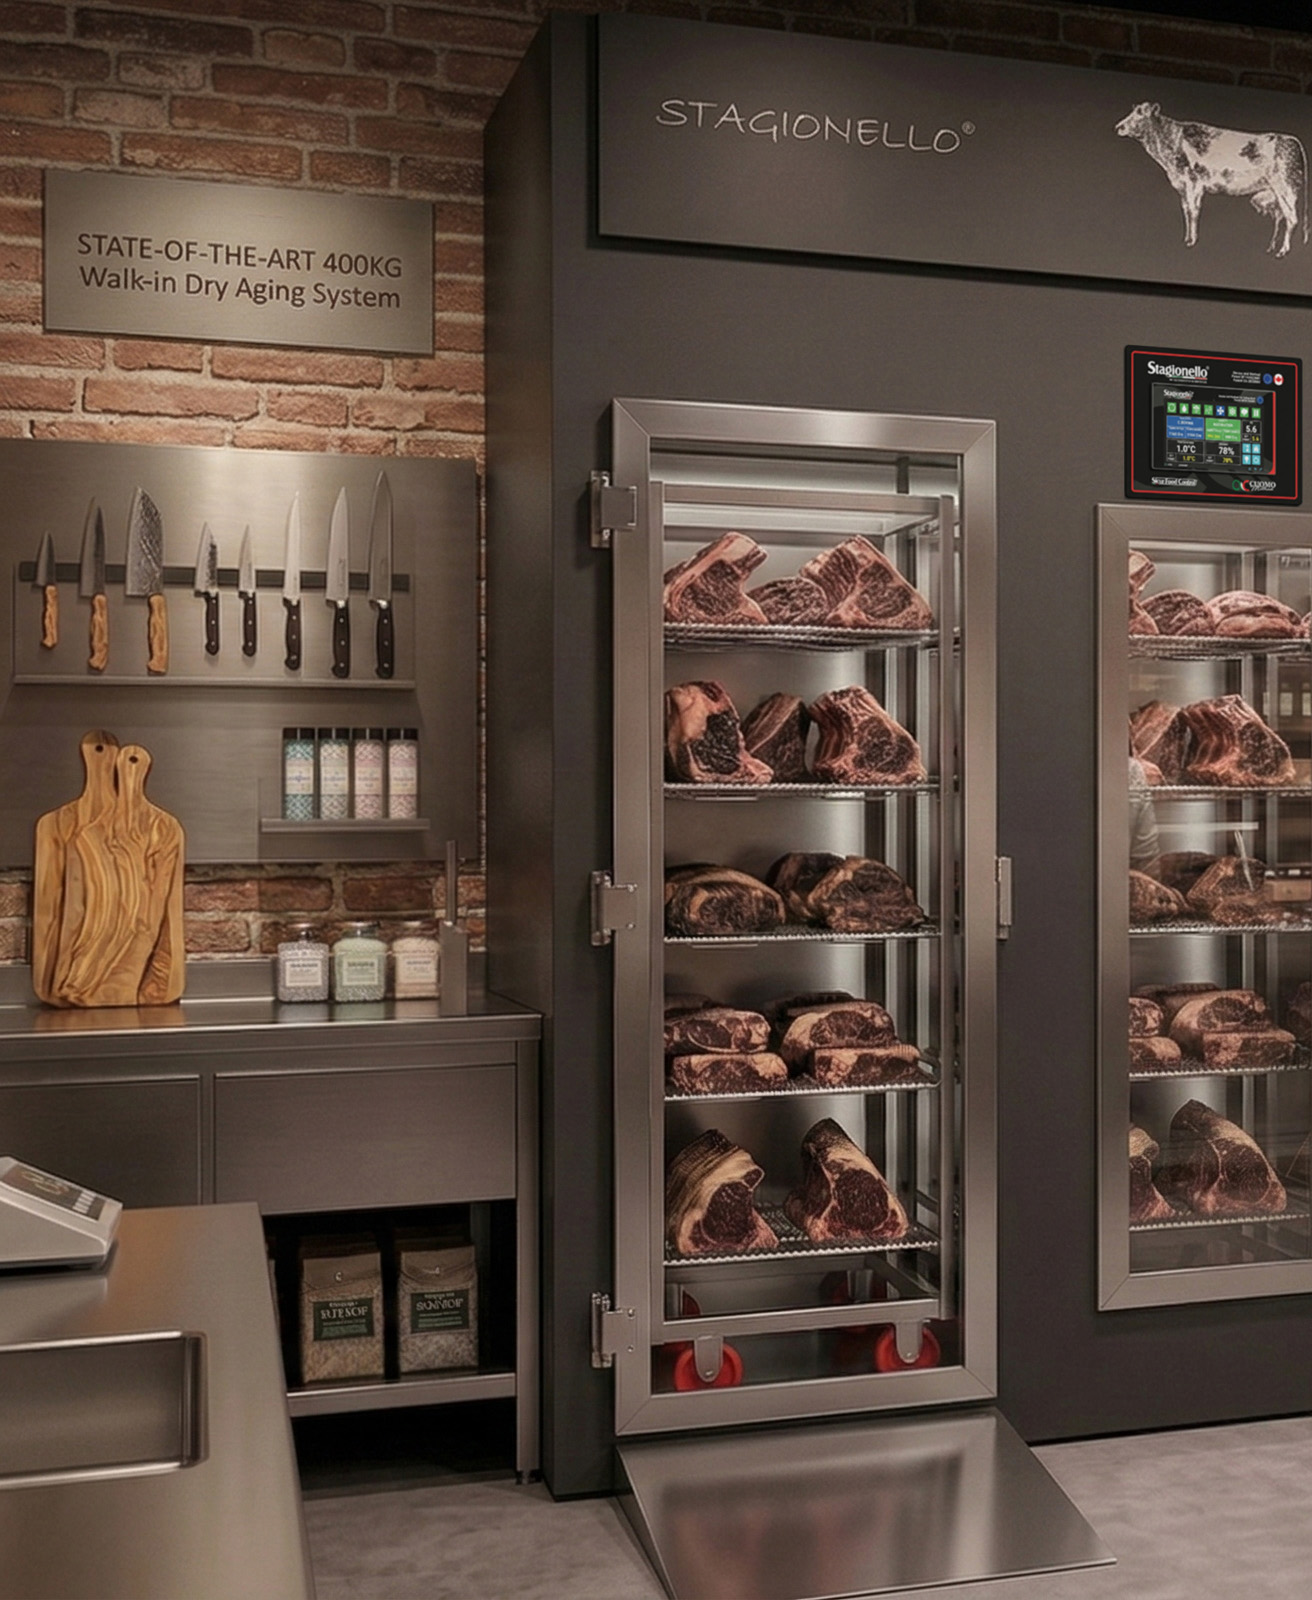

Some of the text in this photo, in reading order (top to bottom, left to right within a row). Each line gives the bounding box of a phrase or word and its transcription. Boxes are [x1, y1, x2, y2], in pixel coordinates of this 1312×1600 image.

[77, 232, 403, 279] STATE-OF-THE-ART 400KG
[78, 265, 401, 310] Walk-in Dry Aging System
[1245, 425, 1258, 433] 5.6
[1218, 446, 1235, 456] 78%
